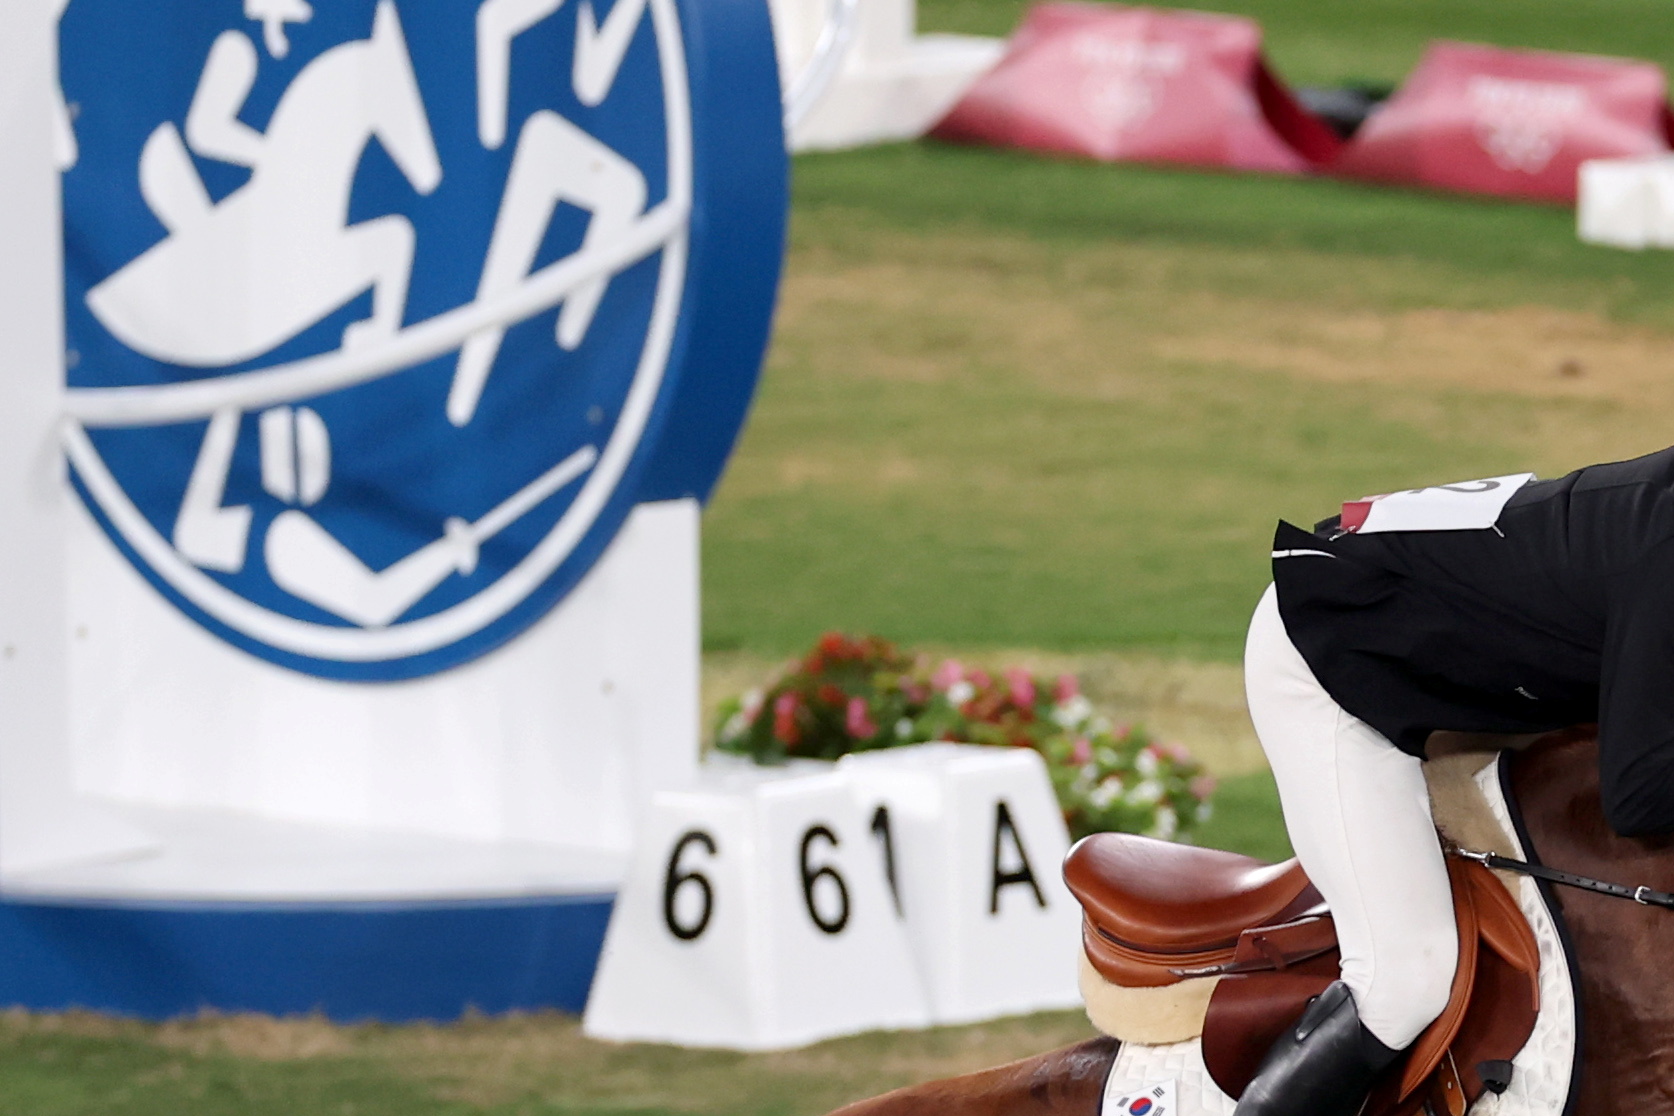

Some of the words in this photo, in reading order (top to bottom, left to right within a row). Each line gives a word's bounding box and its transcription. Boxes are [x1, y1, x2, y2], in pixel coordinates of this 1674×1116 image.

[664, 829, 717, 941] 6
[799, 825, 850, 934] 6
[987, 798, 1050, 915] A
